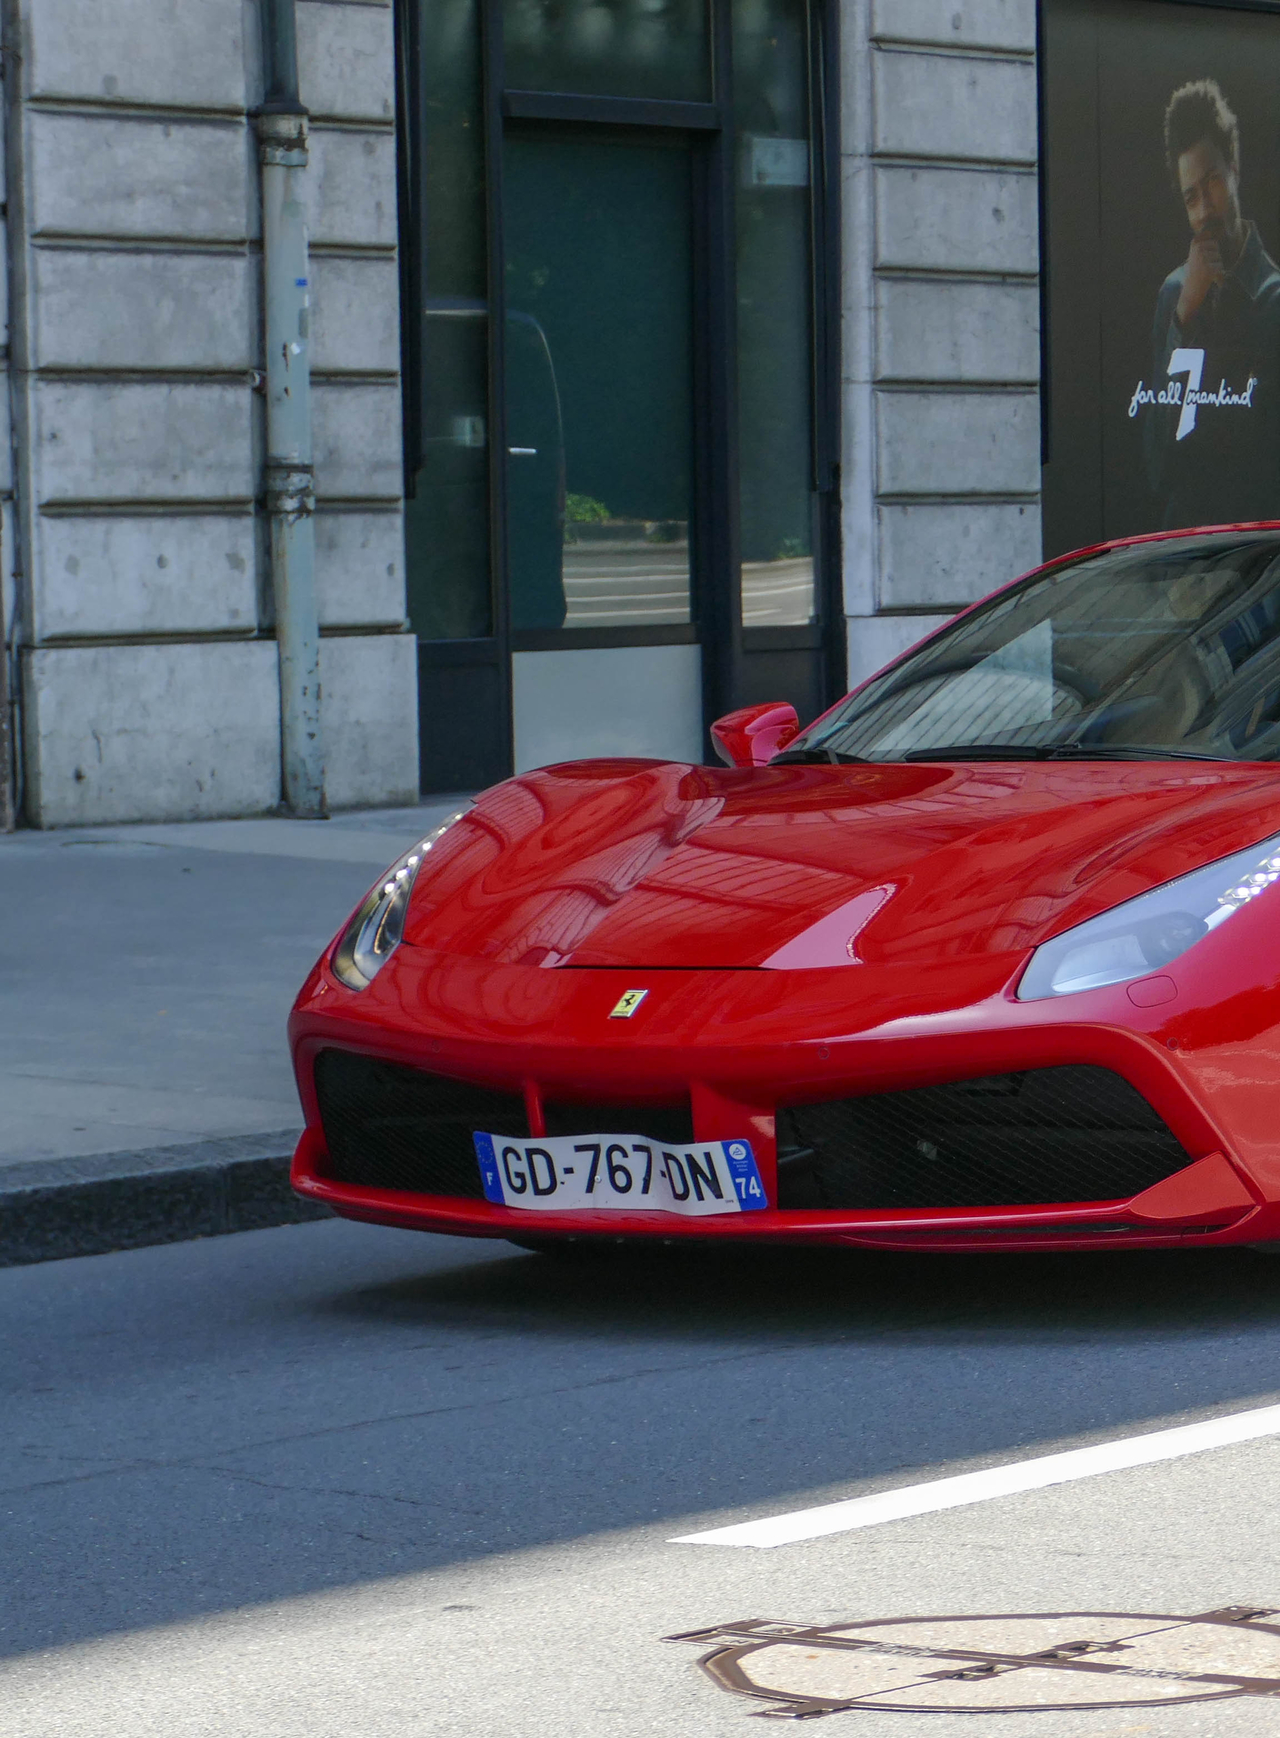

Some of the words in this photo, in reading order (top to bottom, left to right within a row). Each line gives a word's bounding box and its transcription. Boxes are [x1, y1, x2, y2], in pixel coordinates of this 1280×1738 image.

[1128, 380, 1156, 418] for
[1158, 381, 1182, 405] all
[1167, 348, 1205, 441] 7
[486, 1171, 494, 1186] F
[501, 1143, 724, 1202] GD-767-DN
[735, 1175, 761, 1199] 74
